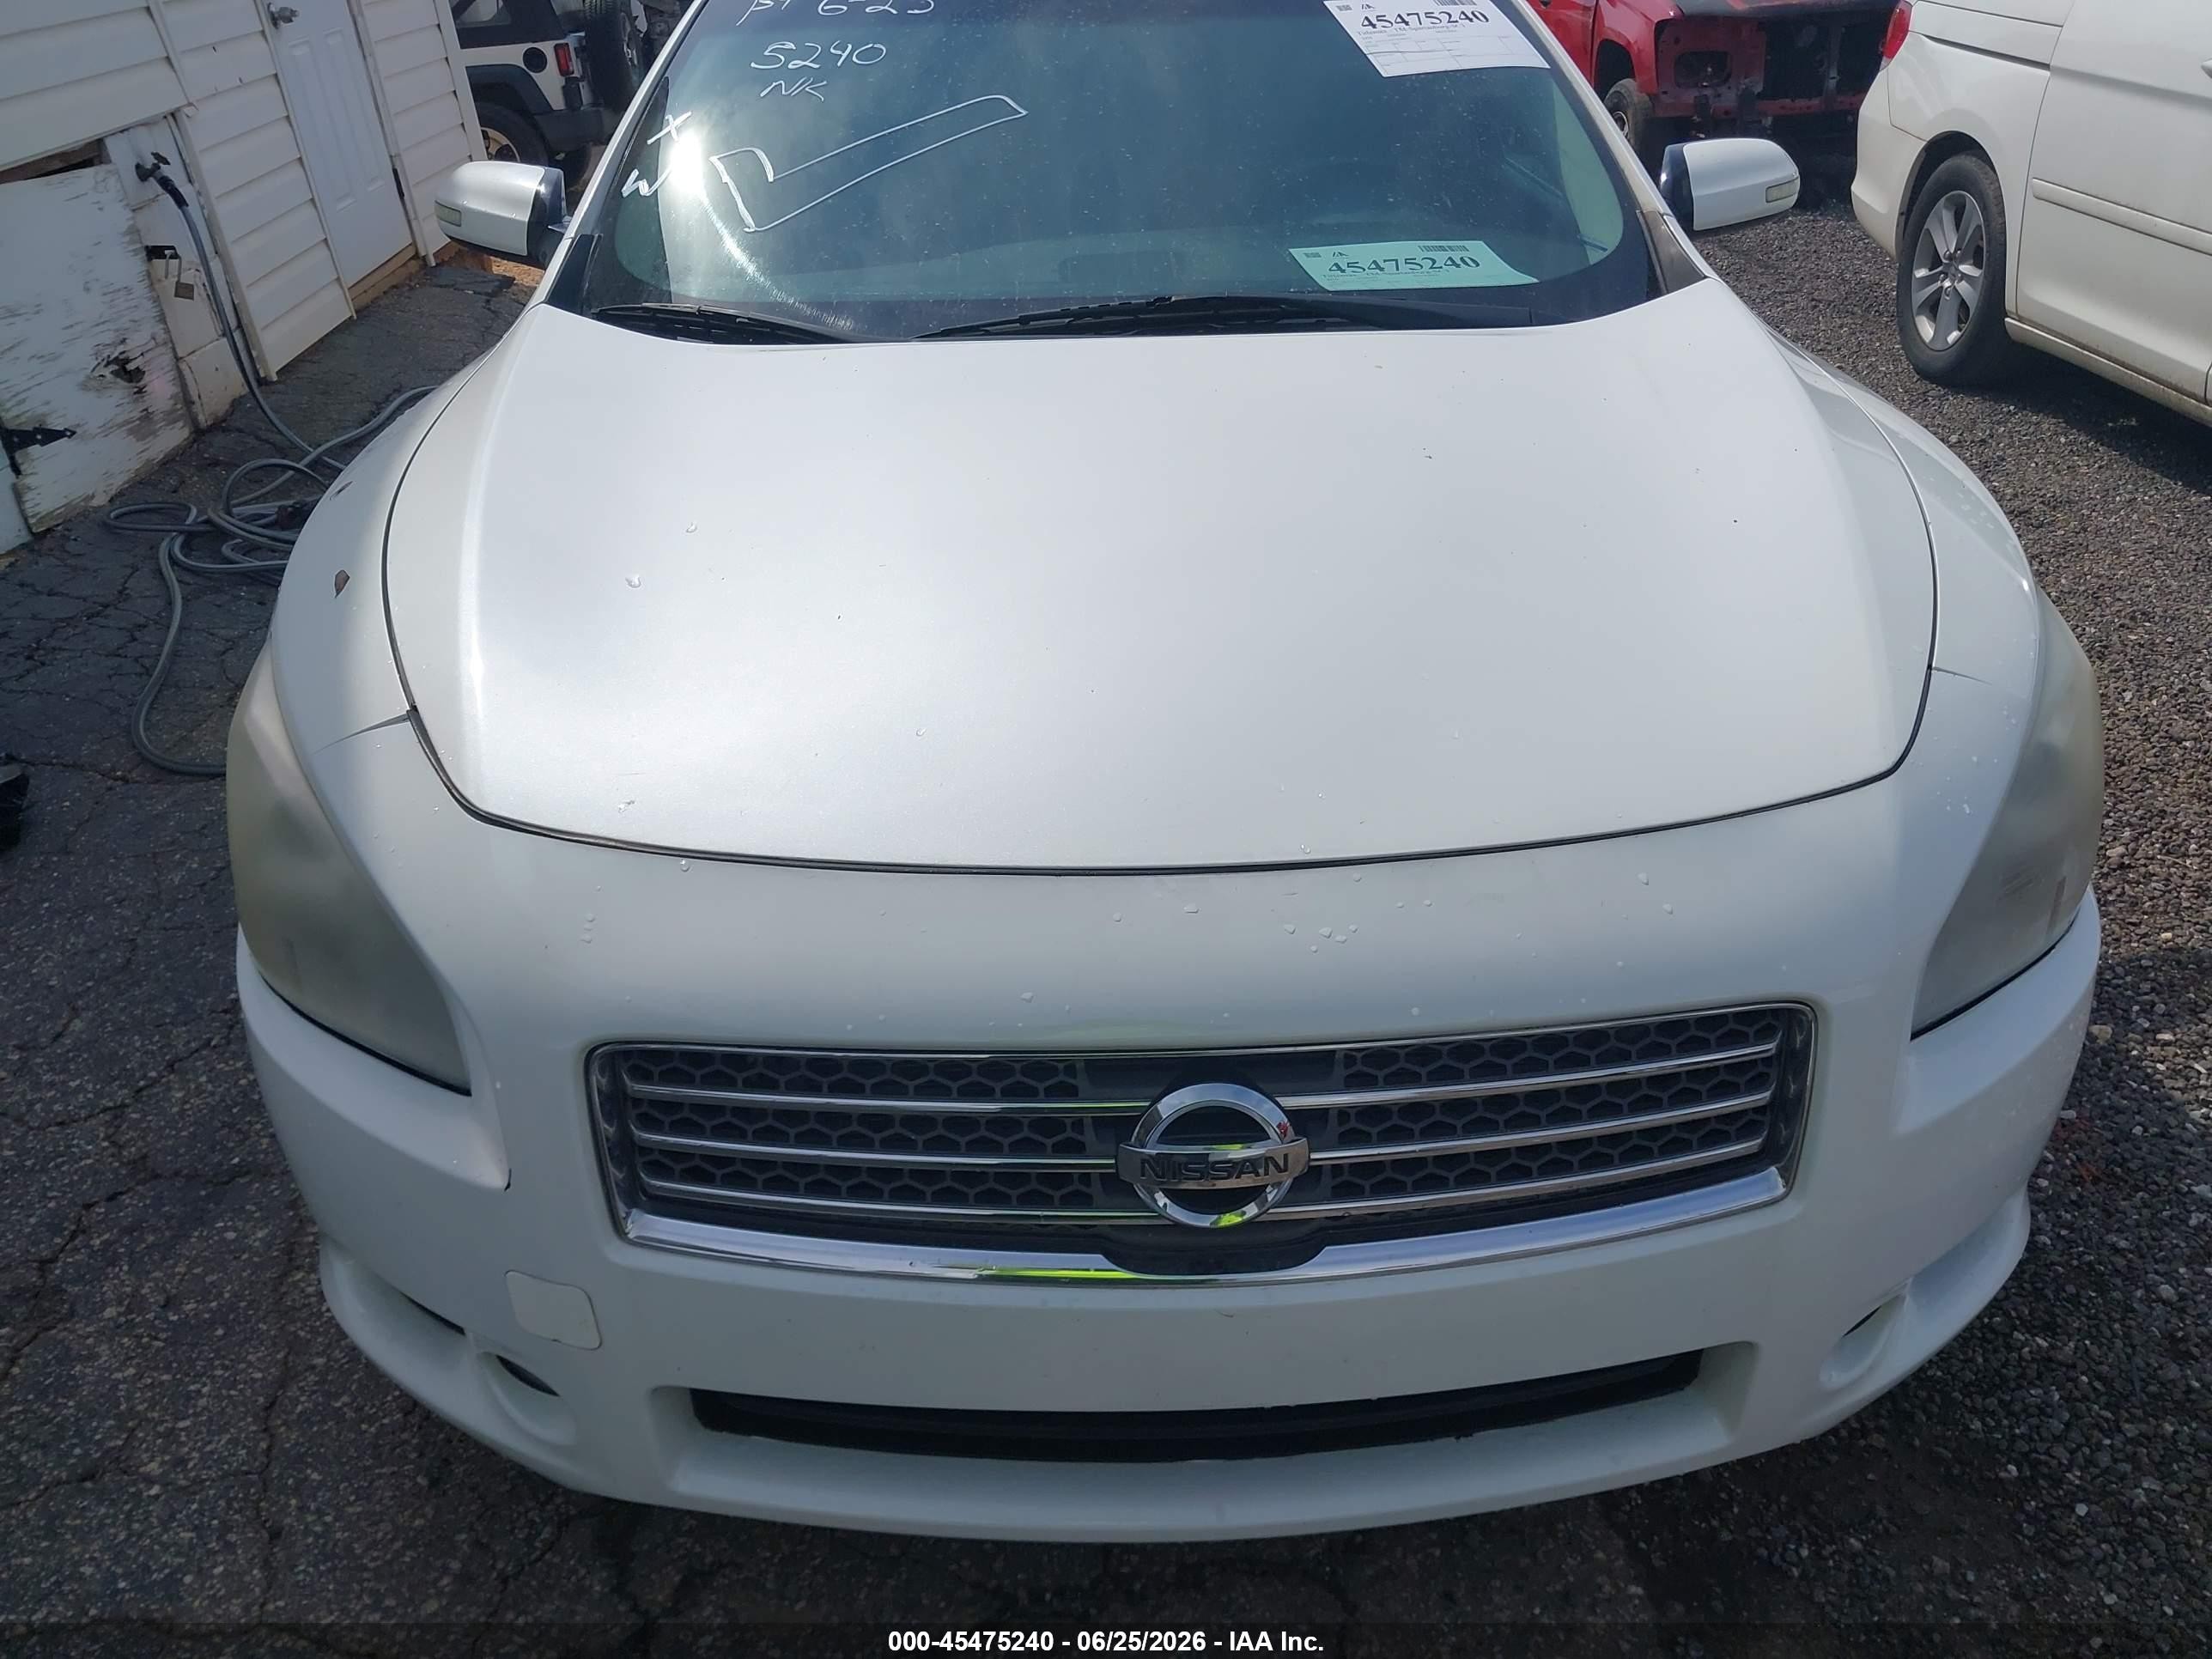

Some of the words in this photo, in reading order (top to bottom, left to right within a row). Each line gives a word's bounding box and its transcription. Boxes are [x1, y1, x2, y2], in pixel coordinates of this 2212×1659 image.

[1361, 10, 1490, 29] 45475240
[750, 41, 886, 70] 5240
[1328, 256, 1480, 274] 45475240
[1140, 1153, 1288, 1181] NISSAN
